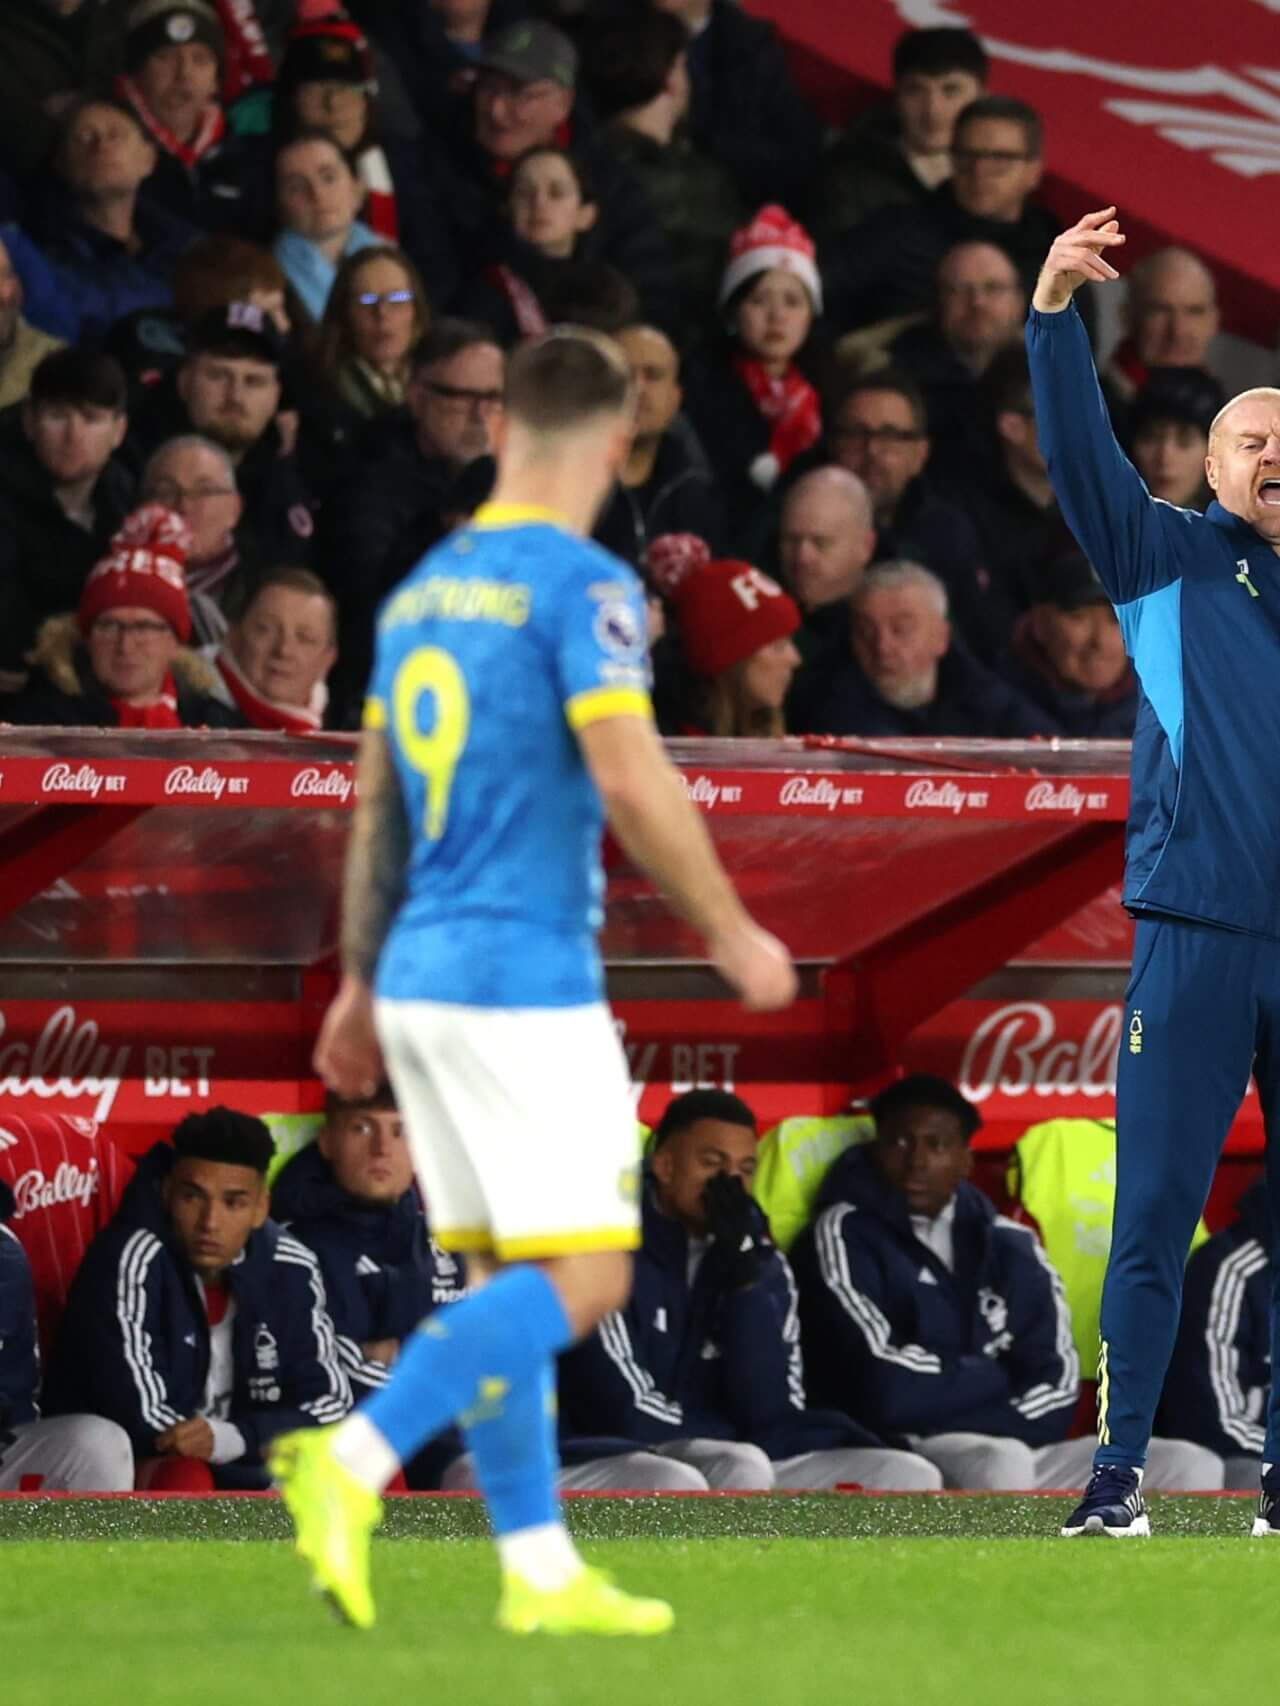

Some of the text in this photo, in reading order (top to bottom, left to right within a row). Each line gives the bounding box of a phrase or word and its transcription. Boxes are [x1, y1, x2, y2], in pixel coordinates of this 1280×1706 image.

[394, 646, 470, 841] 9
[42, 763, 127, 798] Bally BET
[165, 766, 249, 800] Bally BET
[291, 768, 353, 802] Bally
[779, 776, 841, 811] Bally
[904, 778, 966, 814] Bally
[1024, 781, 1086, 816] Bally
[0, 1005, 214, 1123] ally BET
[670, 1043, 742, 1094] BET
[959, 1002, 1123, 1103] Bal
